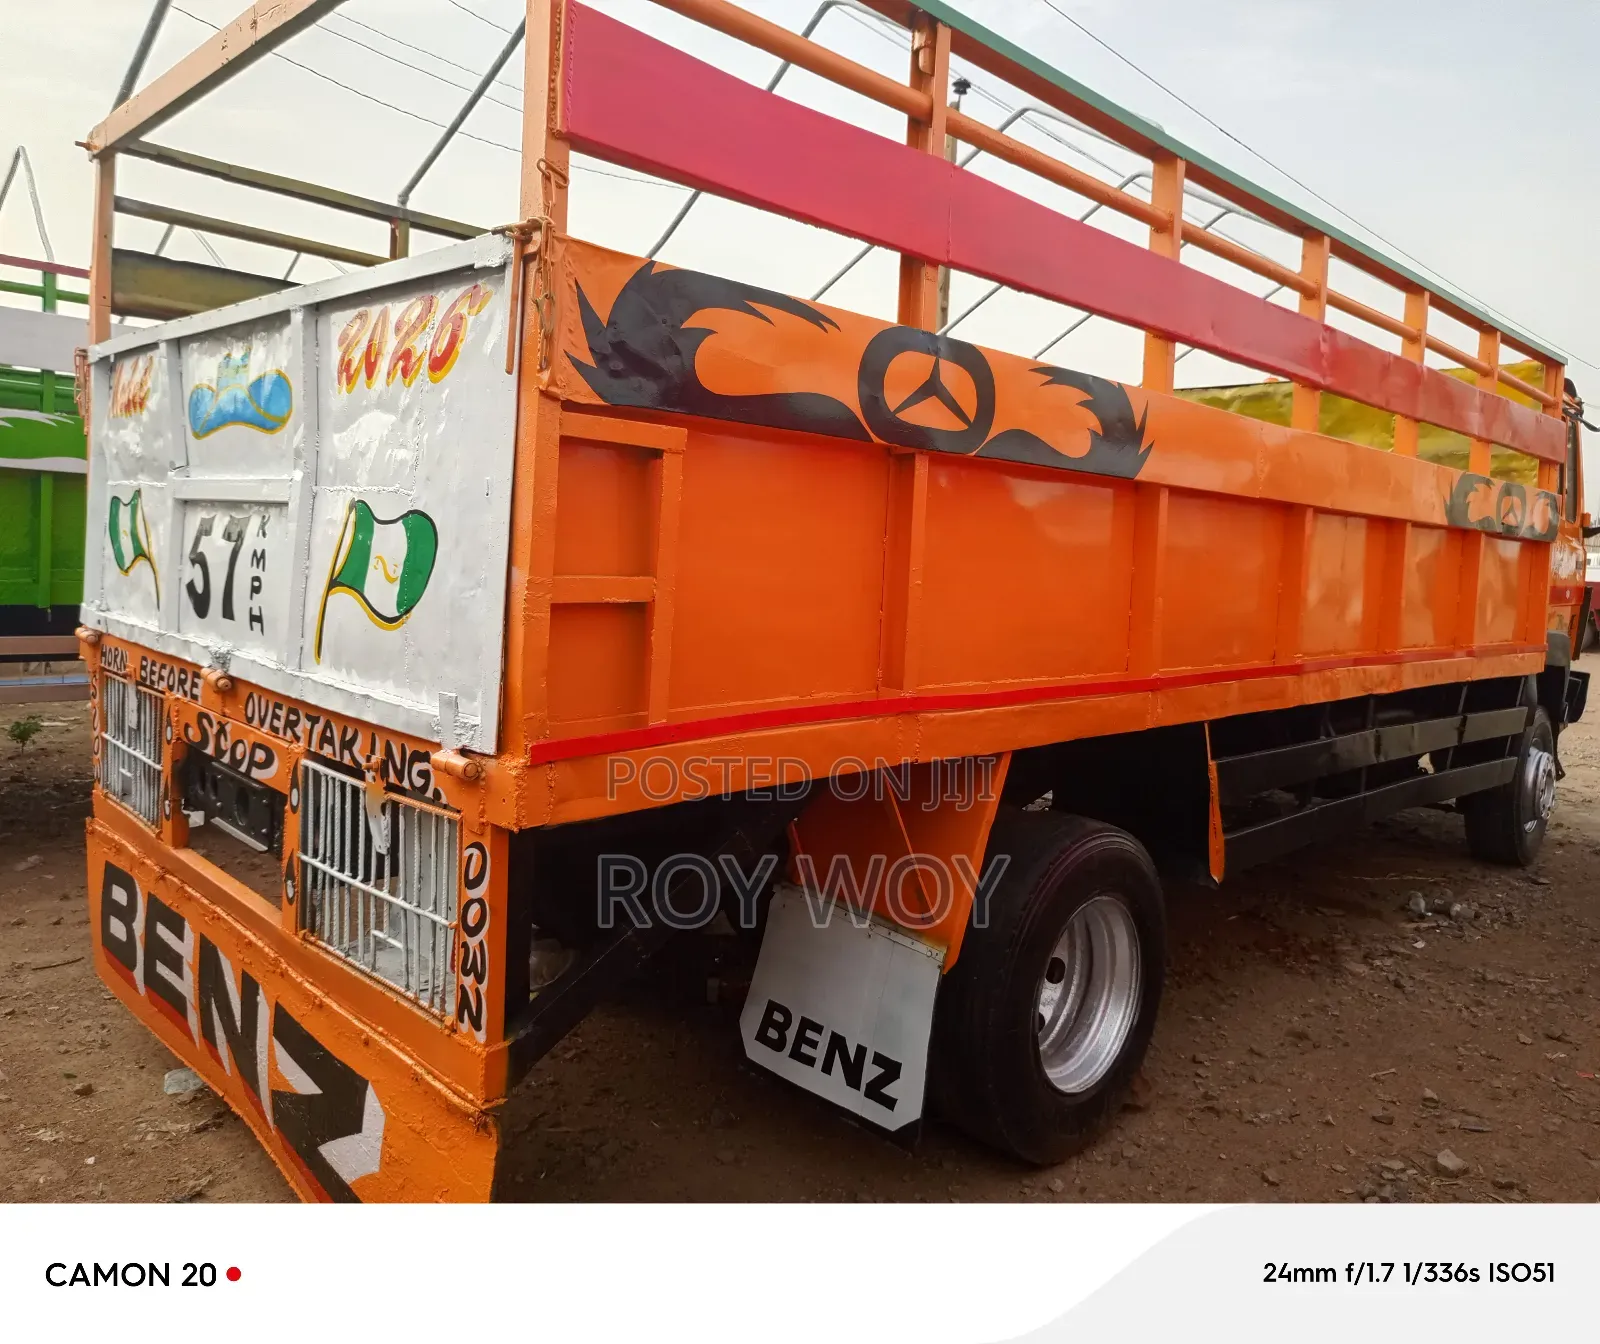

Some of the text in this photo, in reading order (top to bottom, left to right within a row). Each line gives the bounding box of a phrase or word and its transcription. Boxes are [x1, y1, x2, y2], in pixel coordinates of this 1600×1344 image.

[337, 283, 494, 395] 2026
[186, 514, 252, 620] 57
[249, 514, 271, 636] KMPH
[100, 643, 128, 672] HORN
[140, 656, 203, 704] BEFORE
[459, 841, 491, 1043] DOWN
[101, 860, 386, 1203] BENZ
[754, 999, 903, 1112] BENZ
